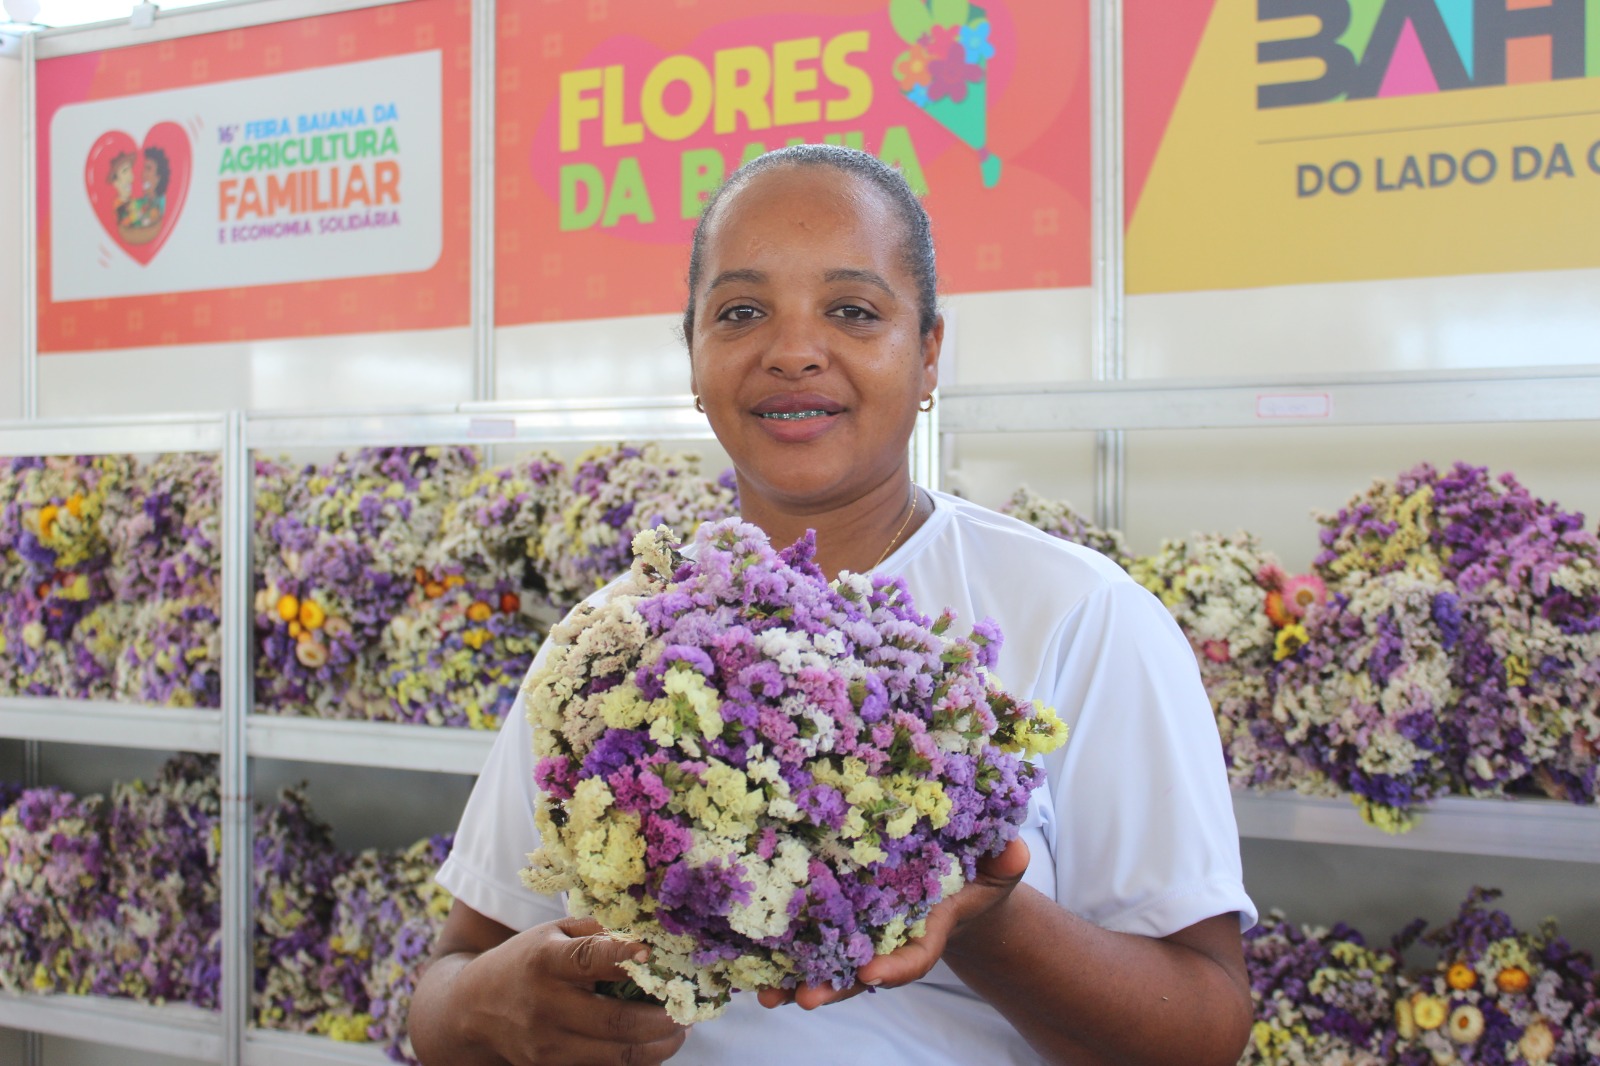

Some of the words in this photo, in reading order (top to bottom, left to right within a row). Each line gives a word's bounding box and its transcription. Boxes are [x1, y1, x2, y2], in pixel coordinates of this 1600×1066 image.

[559, 30, 873, 153] FLORES
[245, 118, 290, 139] FEIRA
[298, 107, 365, 133] BAIANA
[373, 102, 398, 123] DA
[218, 126, 400, 176] AGRICULTURA
[1296, 160, 1362, 198] DO
[1374, 148, 1497, 192] LADO
[1511, 142, 1575, 182] DA
[218, 159, 401, 222] FAMILIAR
[559, 157, 655, 232] DA
[218, 227, 227, 244] E
[232, 219, 311, 242] ECONOMIA
[319, 209, 399, 234] SOLIDÁRIA
